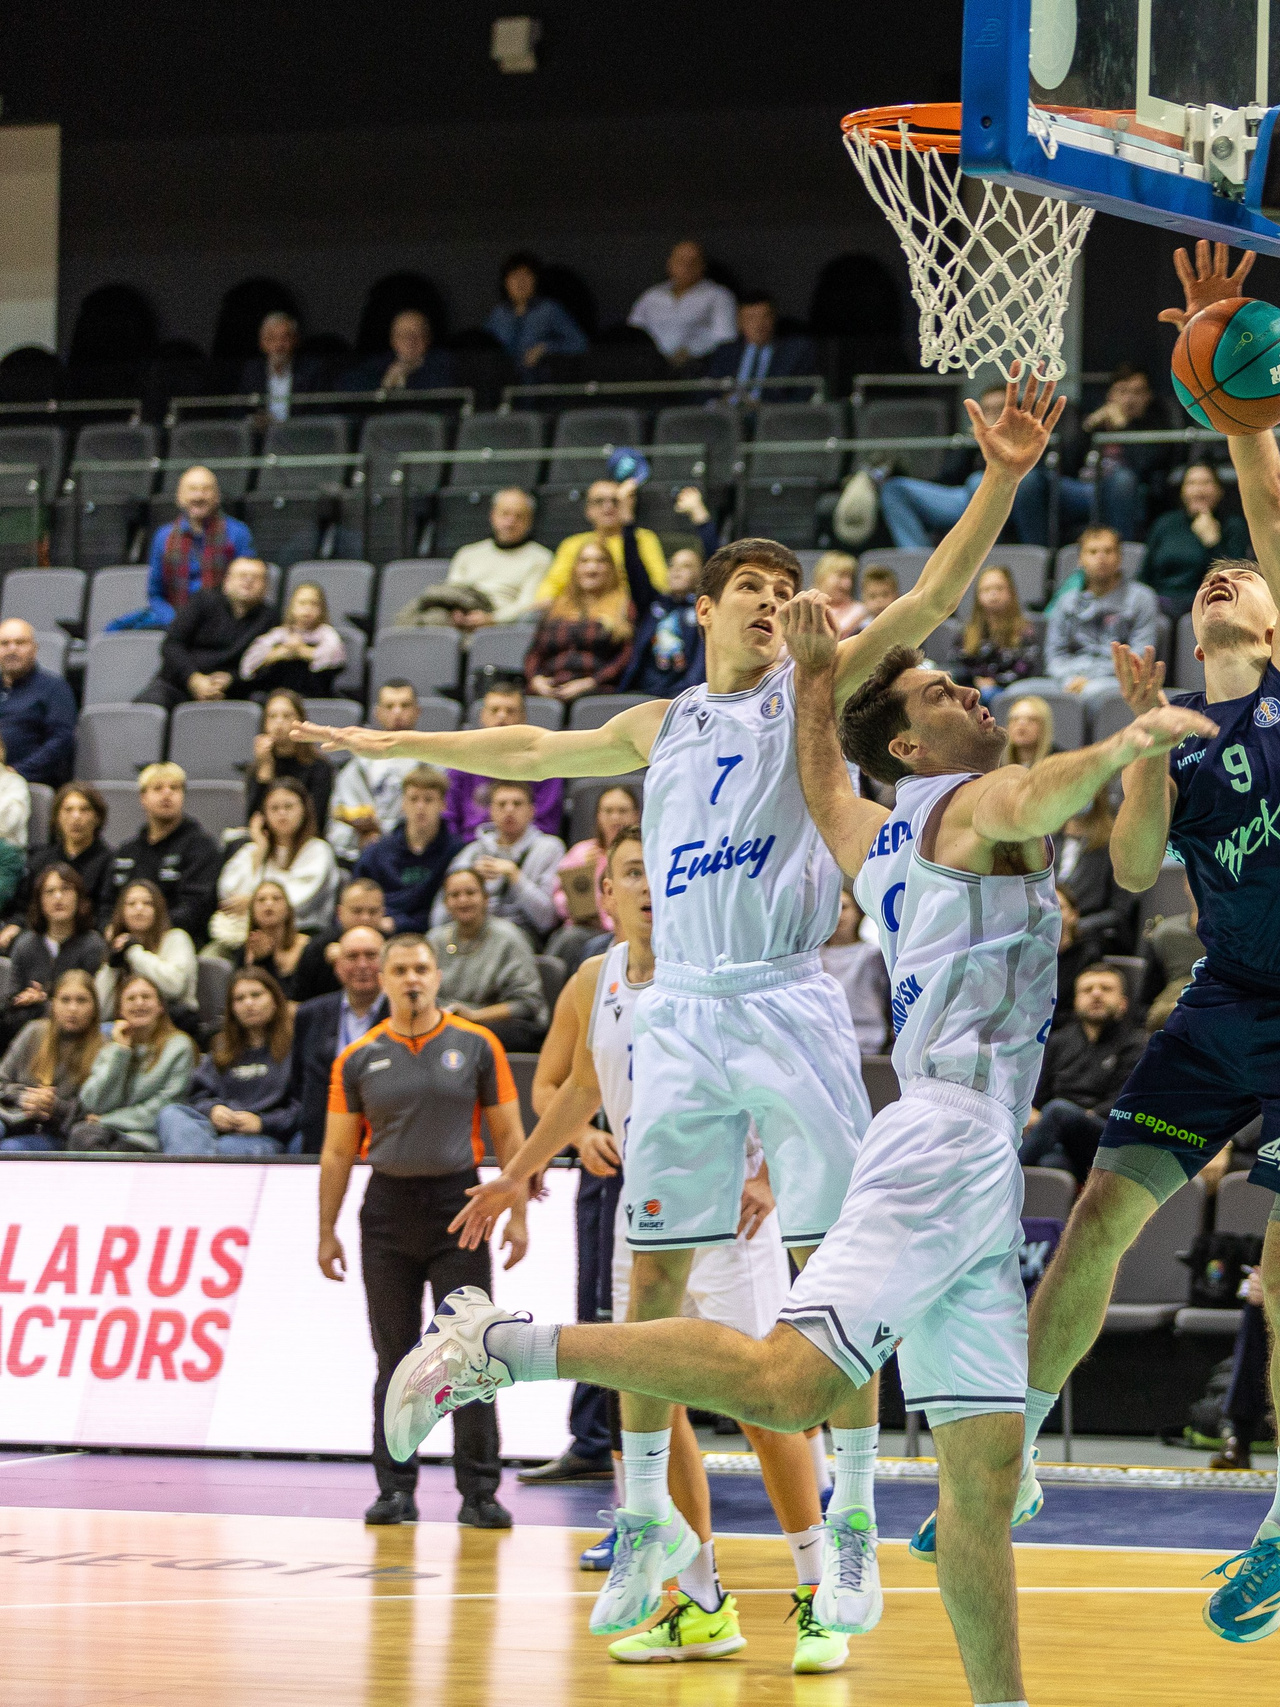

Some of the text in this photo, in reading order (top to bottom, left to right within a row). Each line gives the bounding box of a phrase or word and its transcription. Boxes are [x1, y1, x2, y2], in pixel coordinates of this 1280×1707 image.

[710, 754, 743, 805] 7
[1221, 743, 1252, 793] 9
[665, 834, 776, 898] Enisey
[1134, 1111, 1208, 1149] евроопт
[0, 1224, 250, 1299] LARUS
[0, 1304, 231, 1383] CTORS
